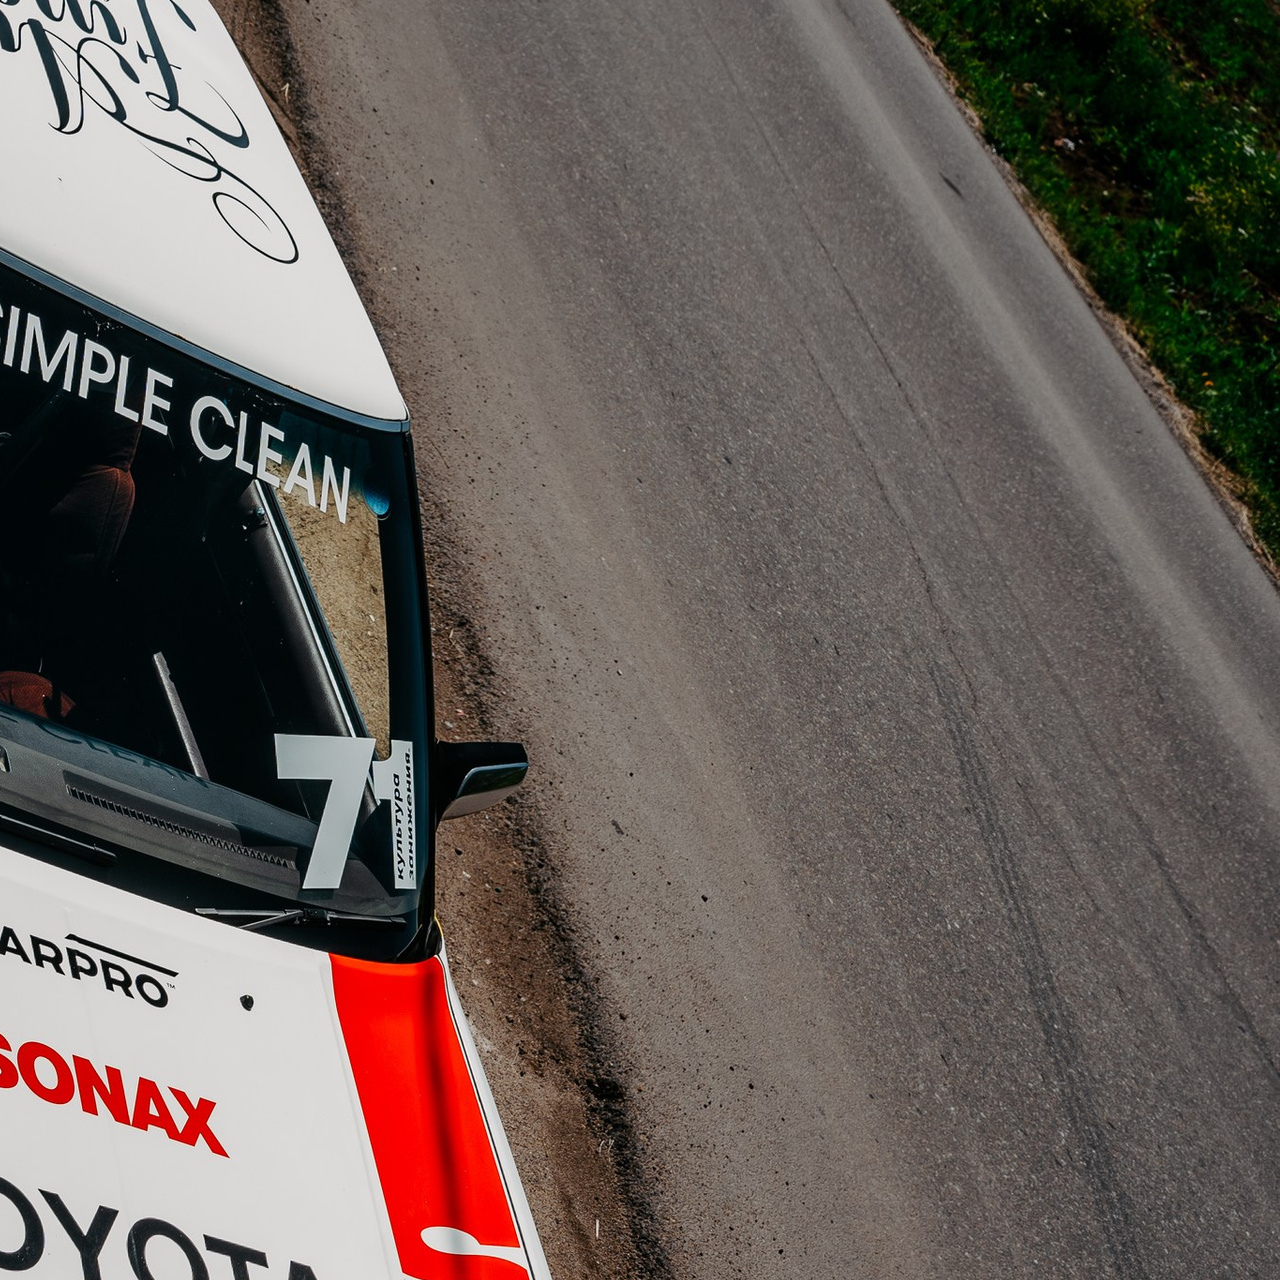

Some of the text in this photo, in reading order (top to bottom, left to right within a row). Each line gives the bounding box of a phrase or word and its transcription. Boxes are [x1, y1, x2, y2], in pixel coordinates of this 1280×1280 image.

[189, 396, 352, 525] CLEAN
[273, 733, 417, 890] 71
[393, 773, 406, 880] культура
